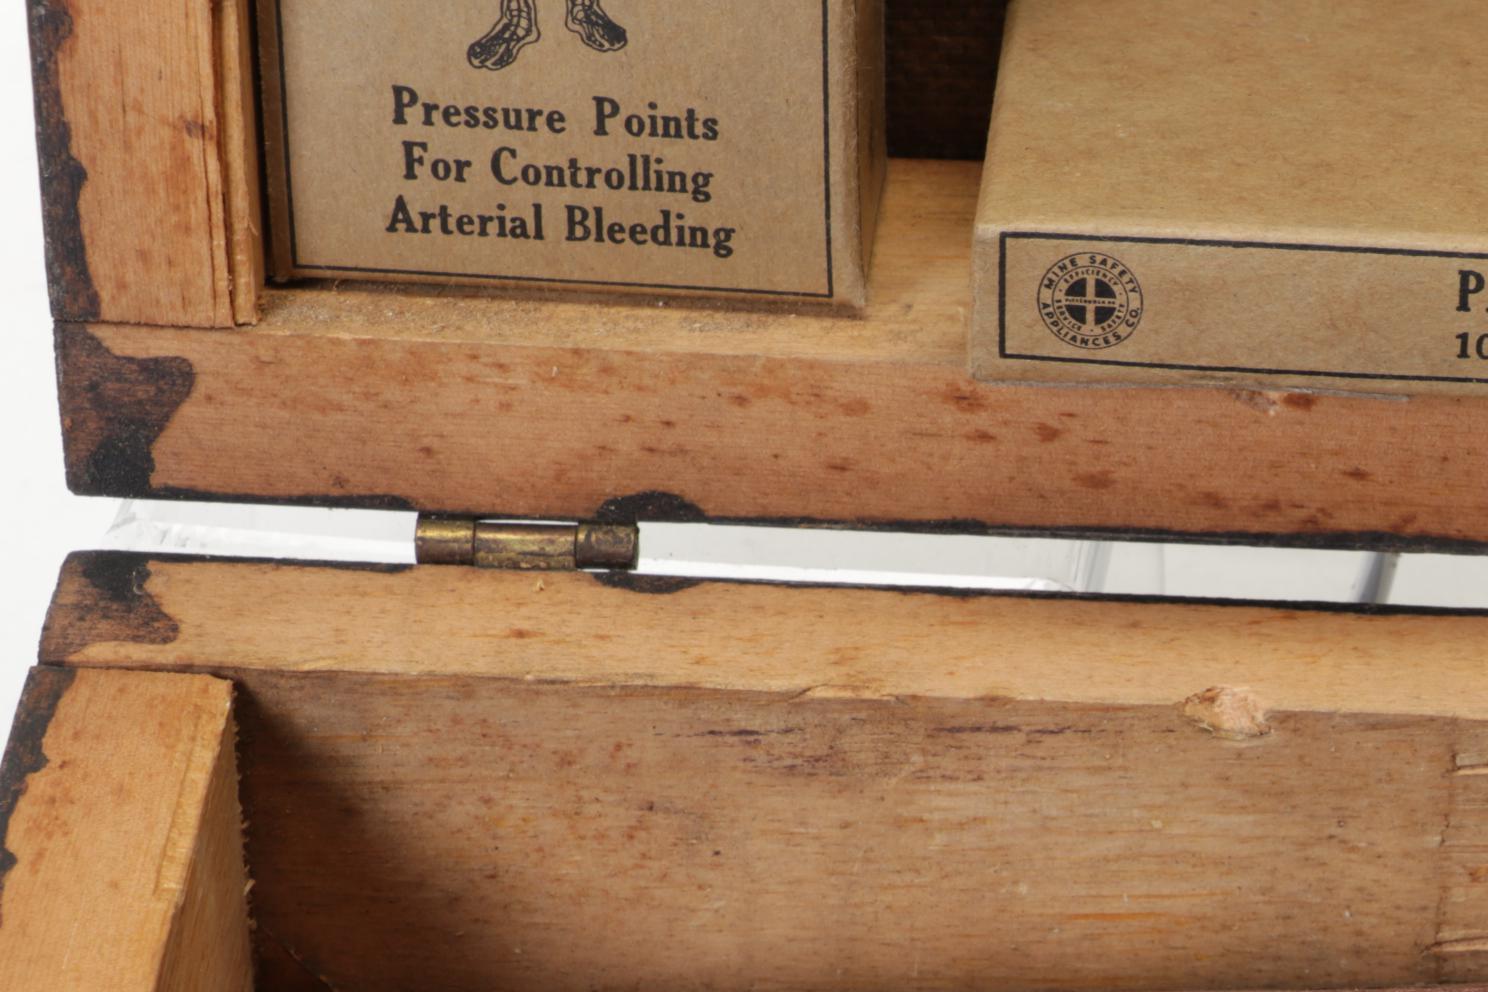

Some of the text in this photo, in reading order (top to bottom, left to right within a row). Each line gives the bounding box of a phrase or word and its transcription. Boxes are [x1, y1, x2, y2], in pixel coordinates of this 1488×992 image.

[391, 84, 720, 141] Pressure Points
[401, 140, 715, 204] For Controlling
[384, 194, 737, 259] Arterial Bleeding
[1043, 254, 1139, 295] MINE SAFETY
[1040, 301, 1141, 348] APPLIANCES CO.
